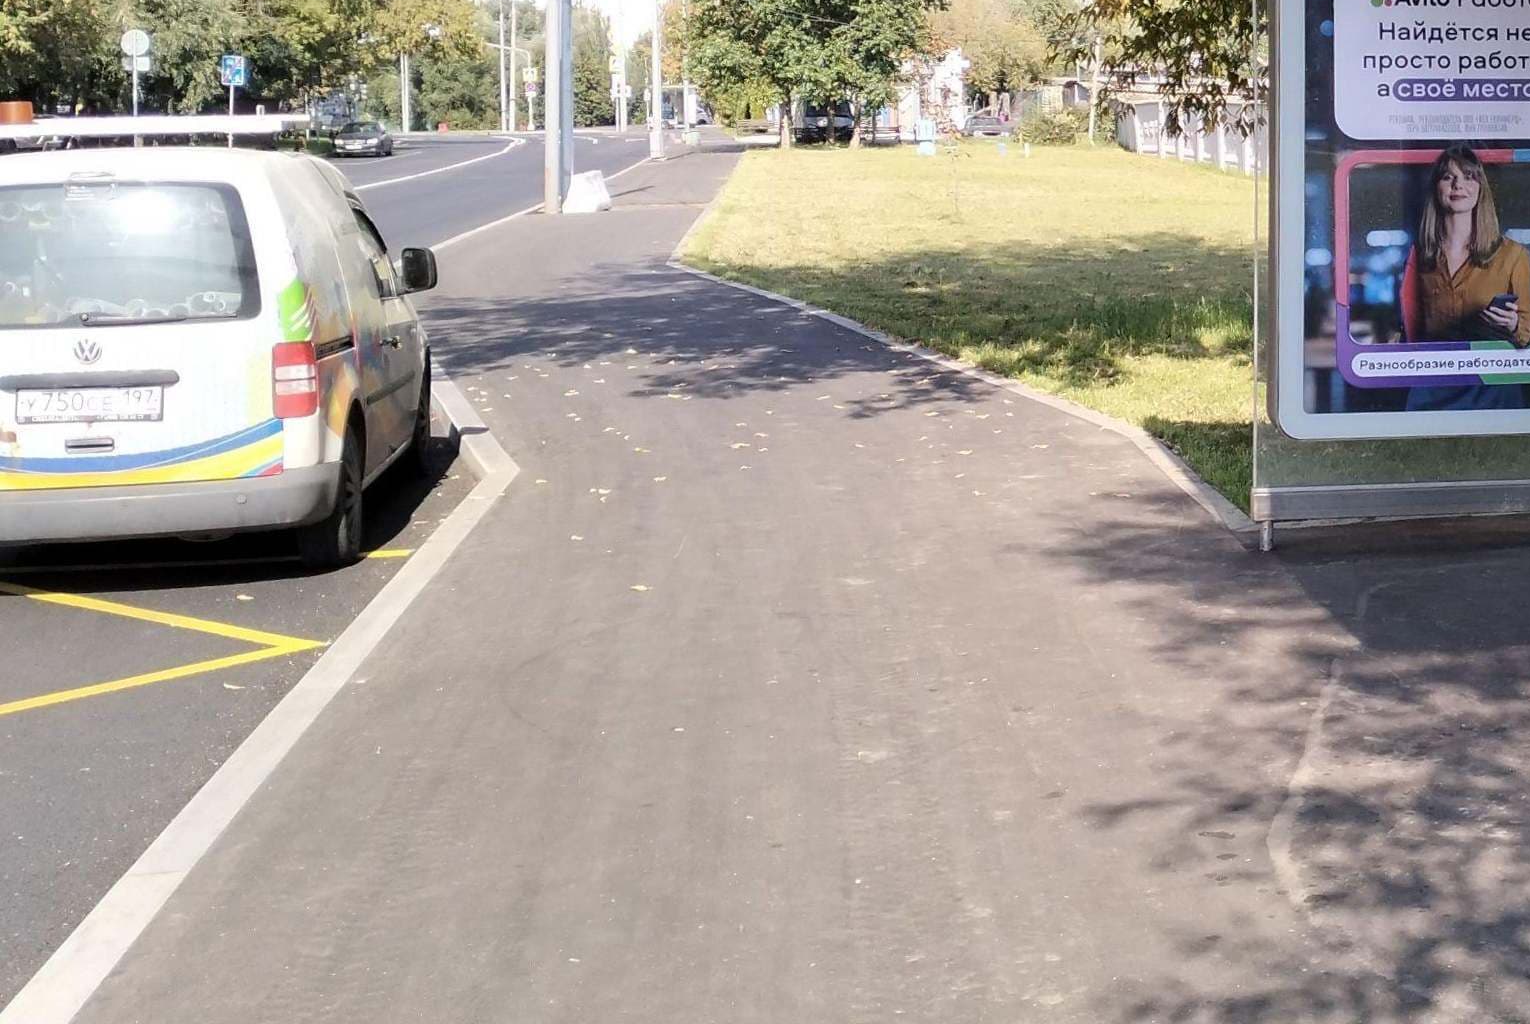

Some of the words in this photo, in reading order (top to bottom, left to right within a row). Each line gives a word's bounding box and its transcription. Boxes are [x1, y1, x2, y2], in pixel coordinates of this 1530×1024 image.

[1378, 22, 1499, 44] Найдётся
[1362, 53, 1451, 73] просто
[1377, 81, 1390, 97] а
[1397, 79, 1456, 98] своё
[1359, 358, 1455, 372] Разнообразие
